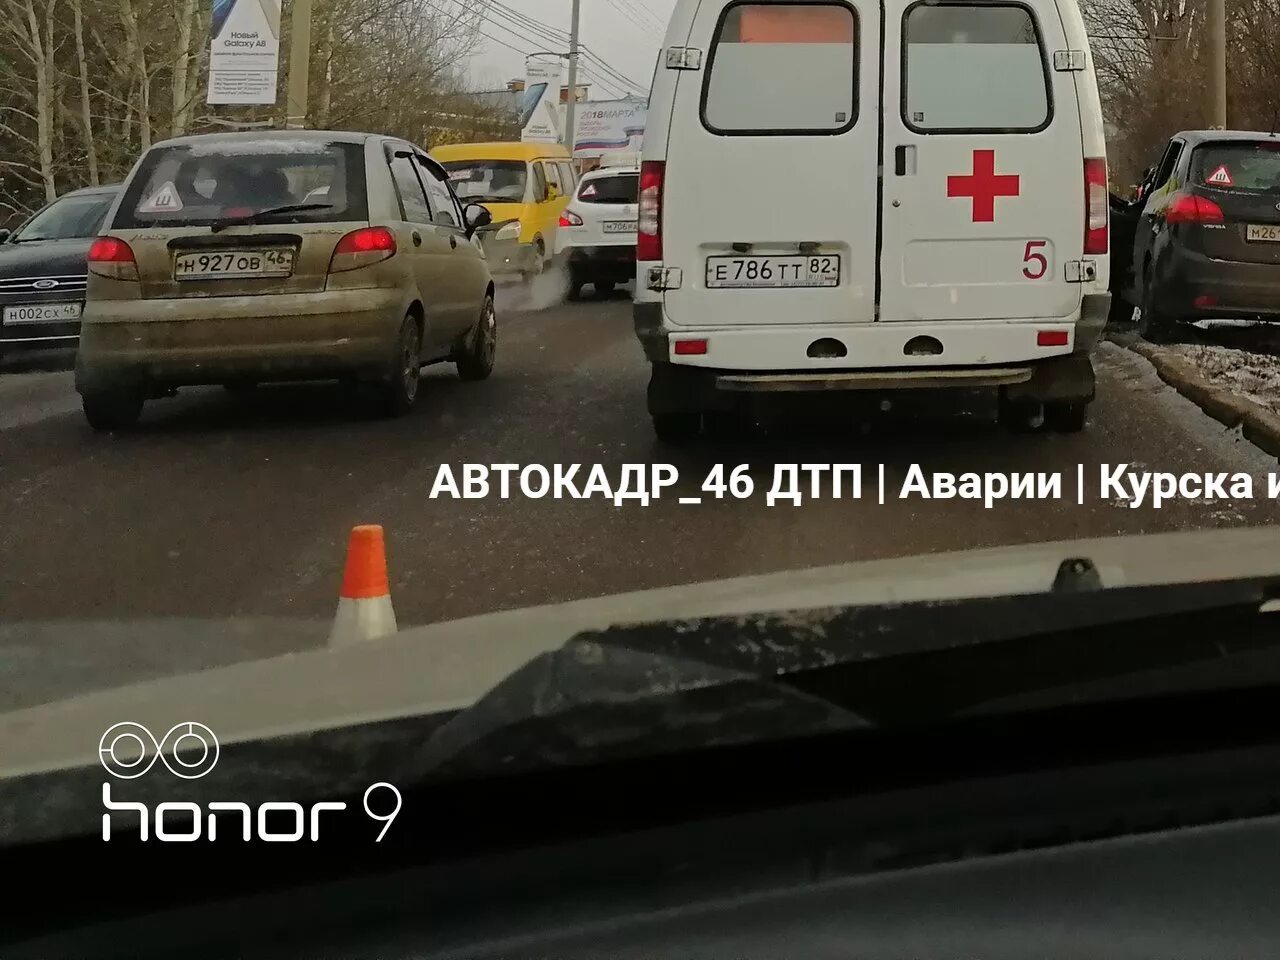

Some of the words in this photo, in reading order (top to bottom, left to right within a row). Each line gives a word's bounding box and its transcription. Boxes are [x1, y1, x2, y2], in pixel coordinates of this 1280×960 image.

[231, 31, 259, 39] Новый
[224, 40, 255, 48] Galaxy
[809, 258, 831, 273] 82
[1023, 241, 1047, 279] 5
